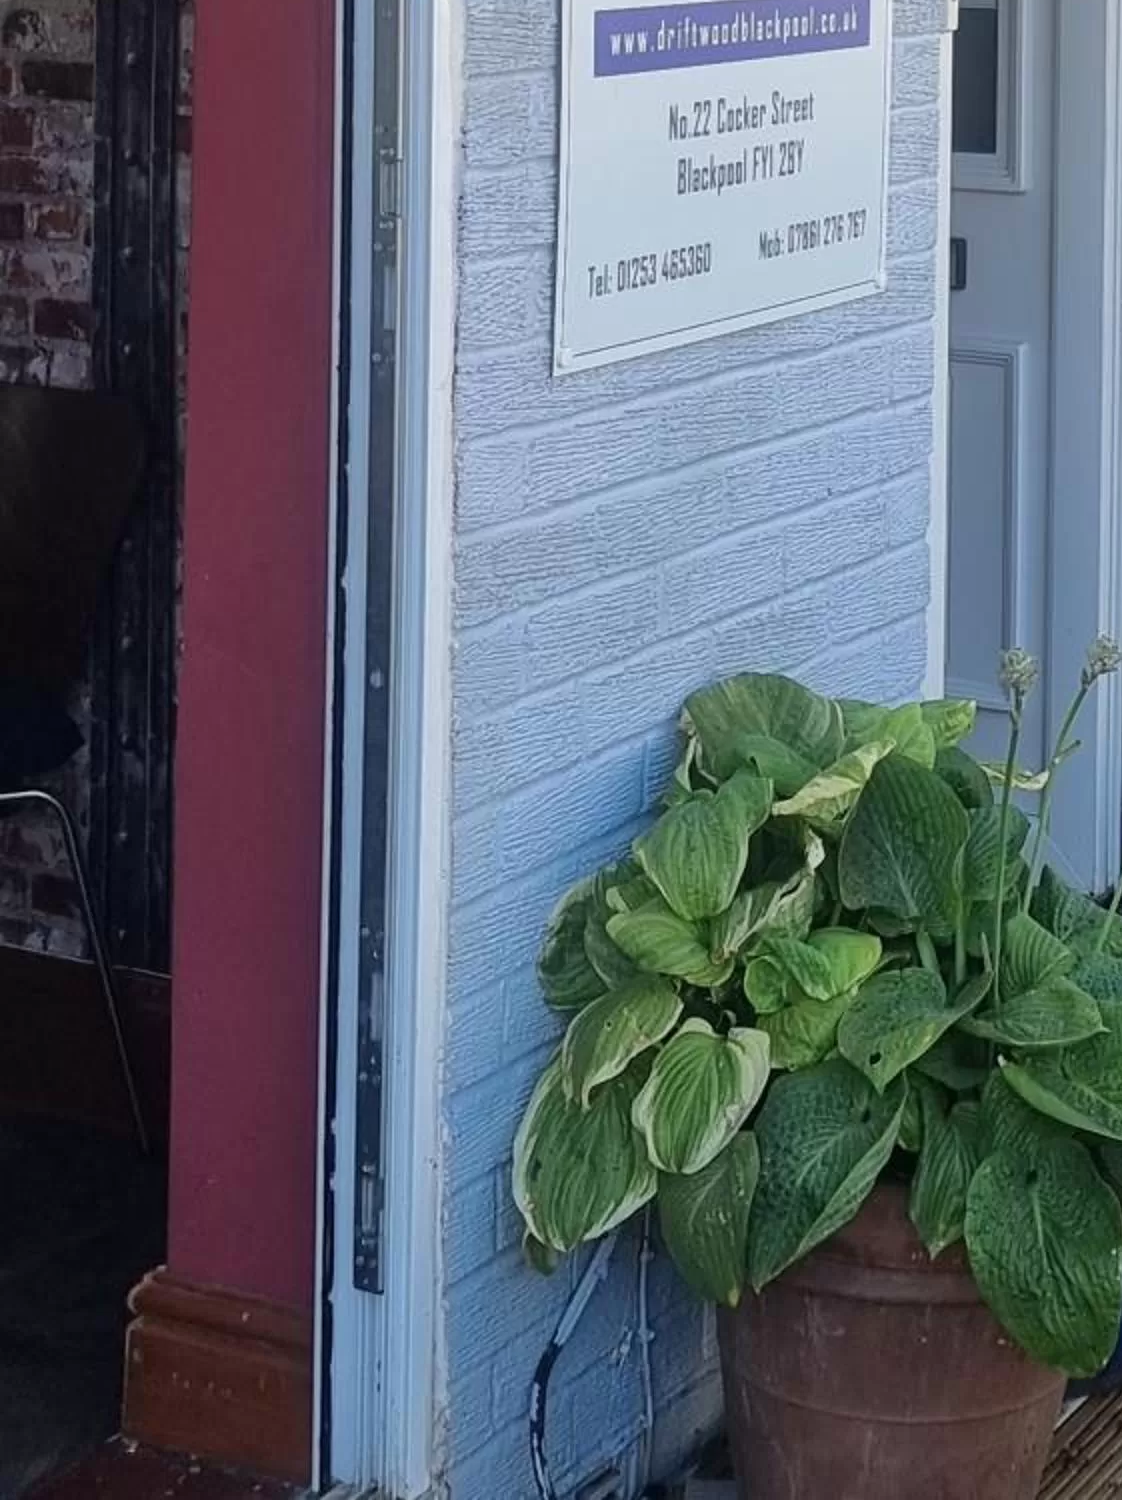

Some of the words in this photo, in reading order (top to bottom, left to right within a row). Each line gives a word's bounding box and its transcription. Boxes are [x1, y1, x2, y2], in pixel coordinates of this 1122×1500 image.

[610, 4, 858, 56] www.driftwoodblackpool.co.uk
[669, 99, 711, 140] No.22
[717, 95, 767, 134] Cocker
[771, 90, 814, 125] Street
[677, 148, 747, 196] Blackpool
[588, 264, 612, 300] Tel:
[618, 254, 656, 292] 01253
